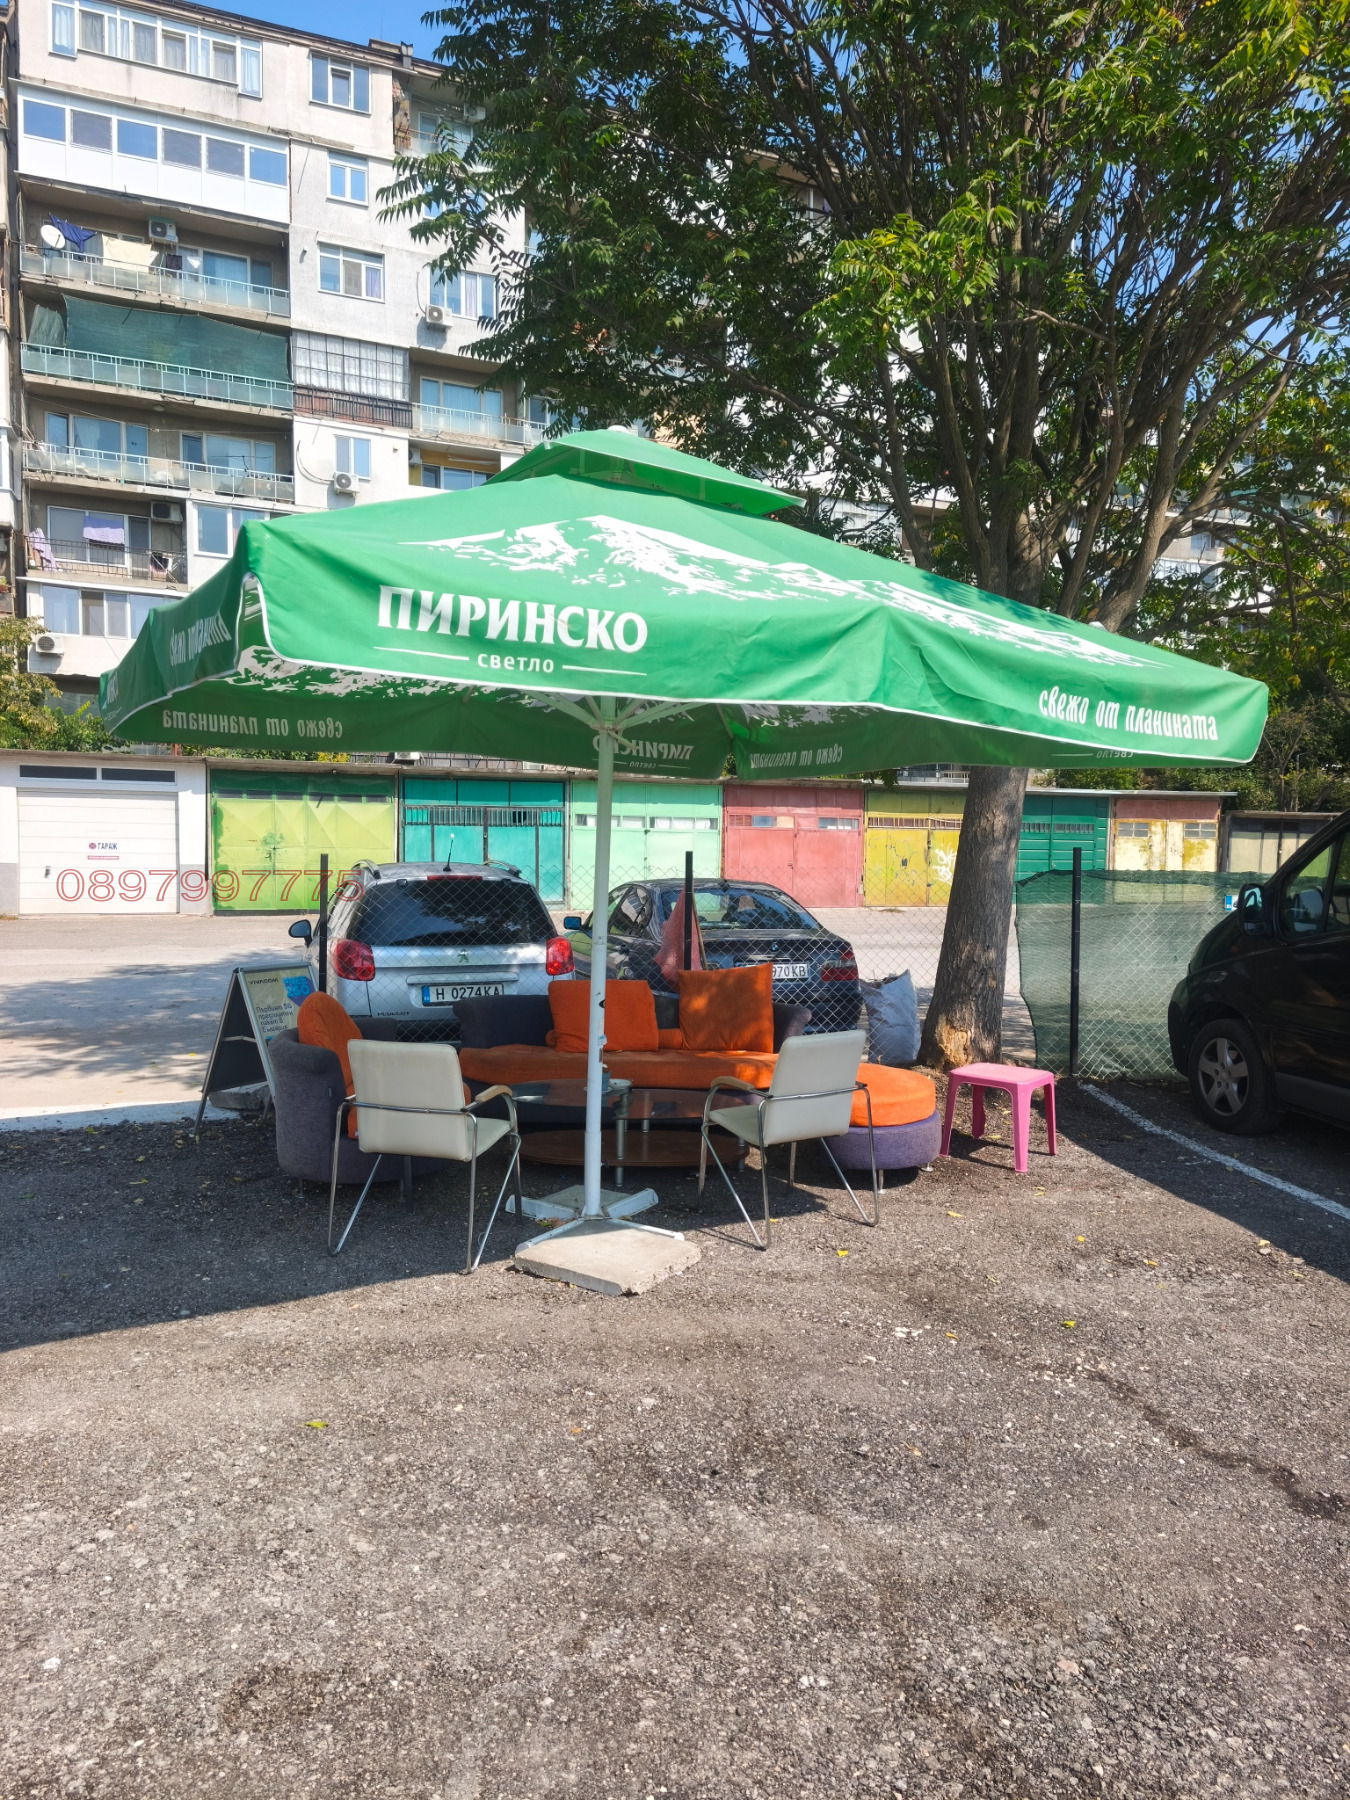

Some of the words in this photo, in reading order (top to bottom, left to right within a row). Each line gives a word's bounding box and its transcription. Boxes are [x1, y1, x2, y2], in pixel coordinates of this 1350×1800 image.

[377, 584, 648, 653] ПИРИНСКО
[477, 653, 554, 673] светло
[1038, 685, 1090, 725] свежо
[1095, 700, 1120, 730] от
[1125, 705, 1219, 741] планината
[97, 842, 118, 850] ГАРАЖ
[771, 966, 806, 977] 970KB
